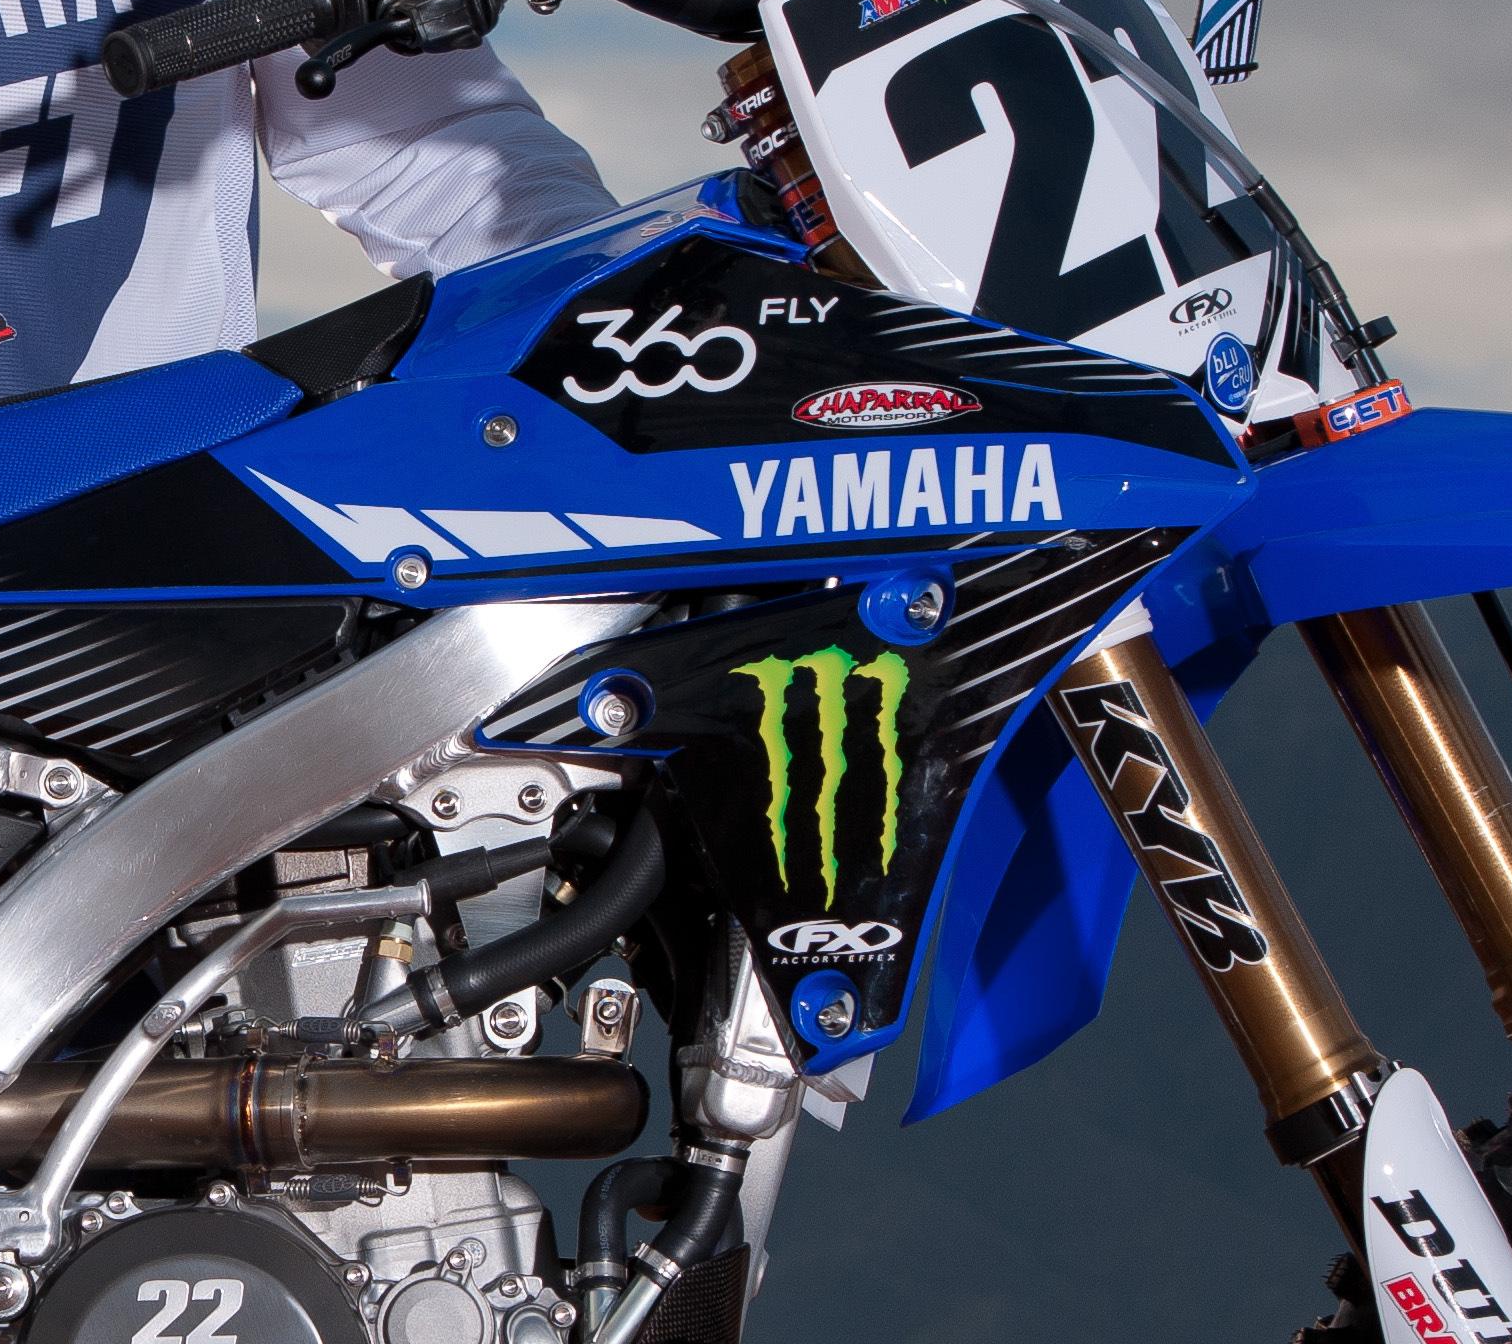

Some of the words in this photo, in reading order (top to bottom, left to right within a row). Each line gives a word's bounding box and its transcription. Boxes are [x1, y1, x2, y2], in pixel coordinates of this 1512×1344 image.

[760, 296, 839, 324] FLY
[562, 305, 758, 404] 360
[795, 389, 983, 420] CHAPARRAL
[827, 411, 947, 425] MOTORSPORTS
[728, 443, 1062, 540] YAMAHA
[784, 920, 888, 954] FX
[772, 955, 841, 965] FACTORY
[848, 953, 896, 963] EFFEX
